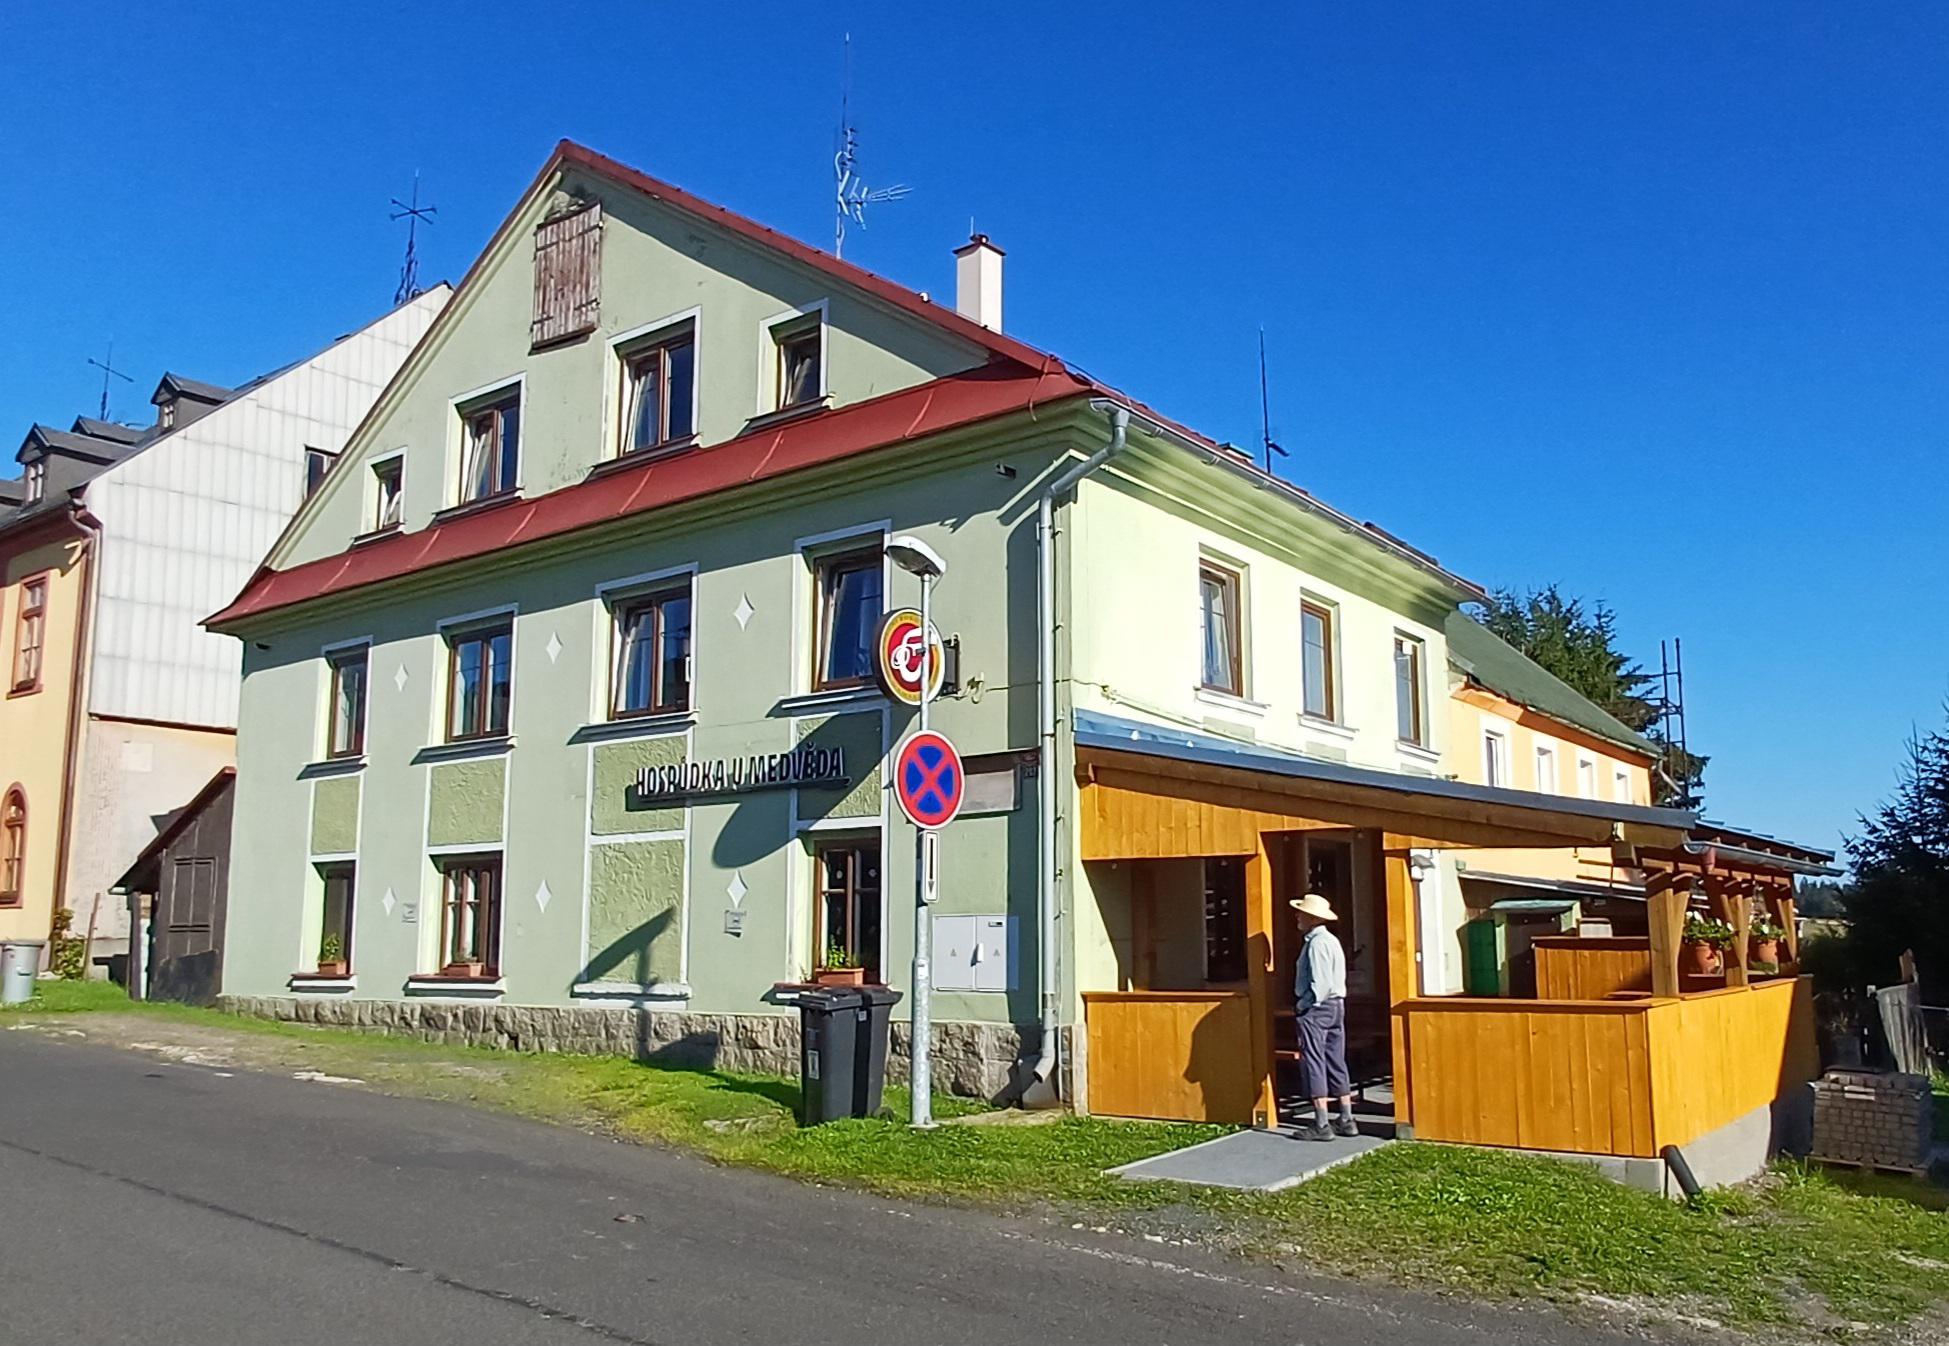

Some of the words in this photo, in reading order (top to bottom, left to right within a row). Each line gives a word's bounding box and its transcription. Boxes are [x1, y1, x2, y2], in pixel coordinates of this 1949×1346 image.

[636, 756, 727, 795] HOSPŮDKA
[733, 756, 743, 788] U
[749, 743, 844, 784] MEDVĚDA
